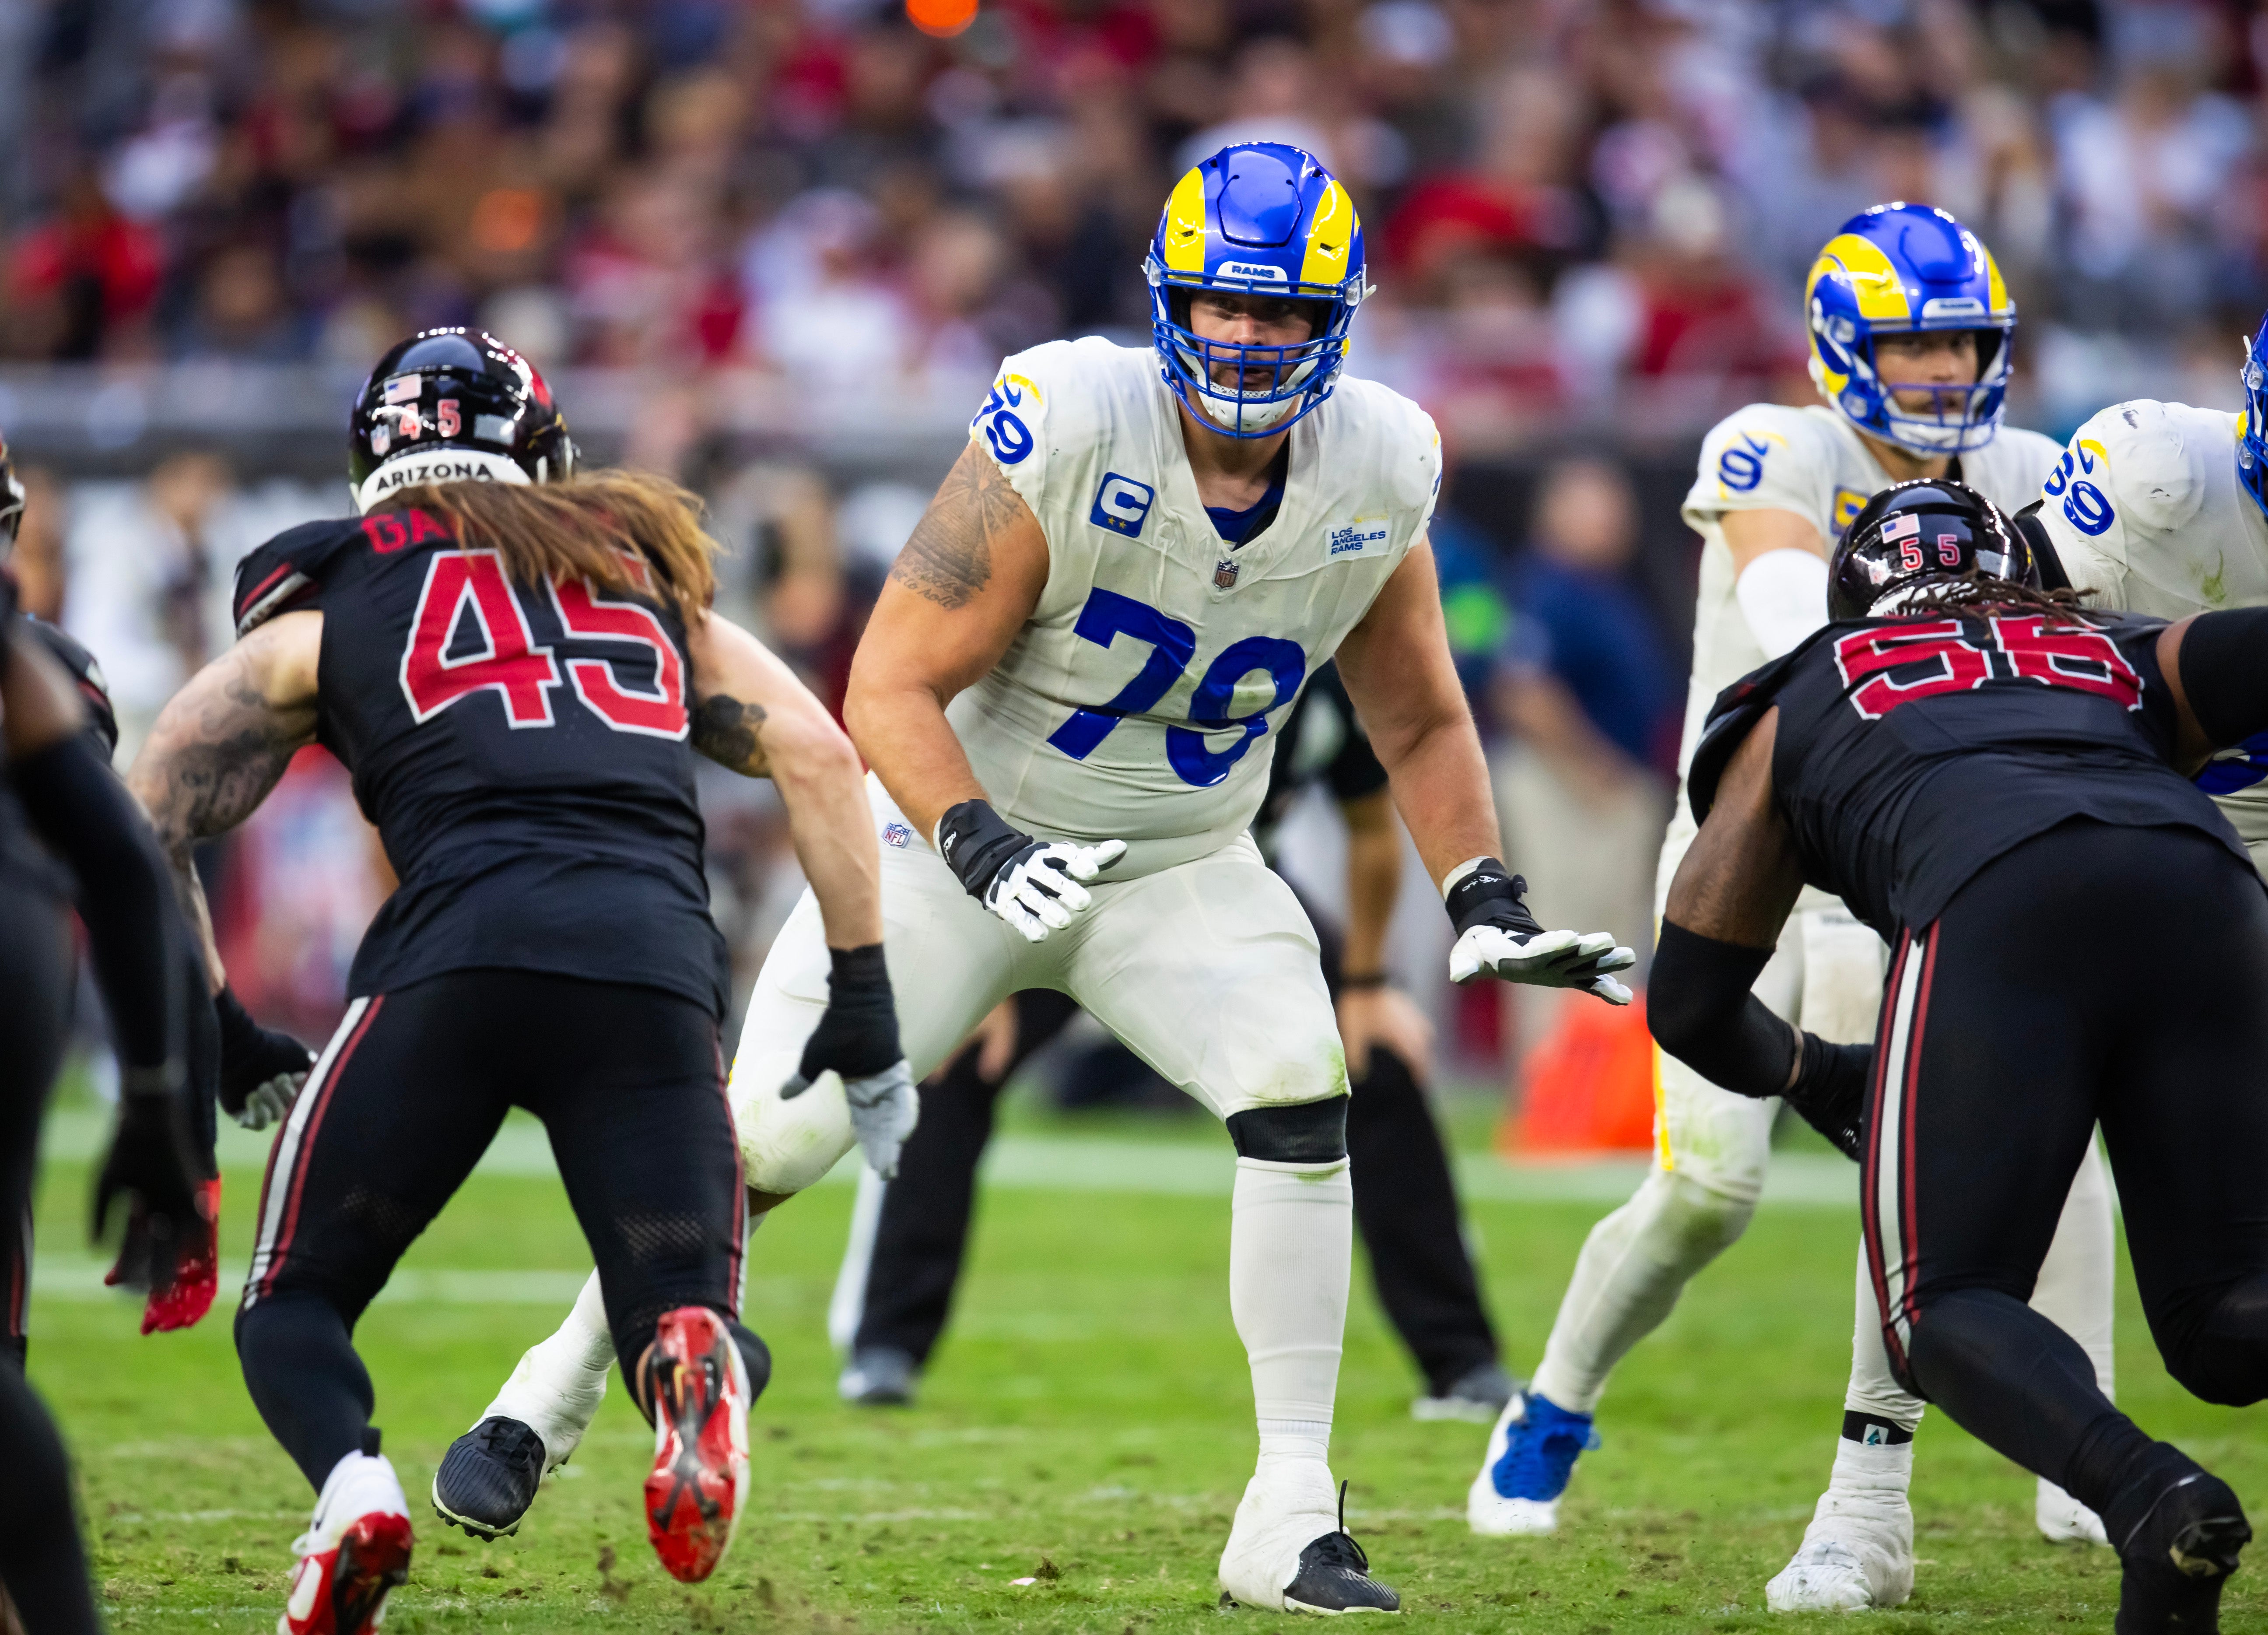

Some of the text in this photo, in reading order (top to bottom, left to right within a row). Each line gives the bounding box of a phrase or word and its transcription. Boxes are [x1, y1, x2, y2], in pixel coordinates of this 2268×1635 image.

[1232, 265, 1275, 279] RAMS
[973, 386, 1034, 465] 79
[377, 462, 495, 493] ARIZONA
[1718, 448, 1763, 493] 9
[1100, 478, 1150, 522] C
[1331, 531, 1386, 547] ANGELES
[1332, 527, 1353, 539] LOS
[1331, 542, 1363, 556] RAMS
[904, 576, 958, 607] to roll
[399, 548, 690, 742] 45
[1046, 586, 1306, 787] 79
[884, 830, 903, 844] NFL
